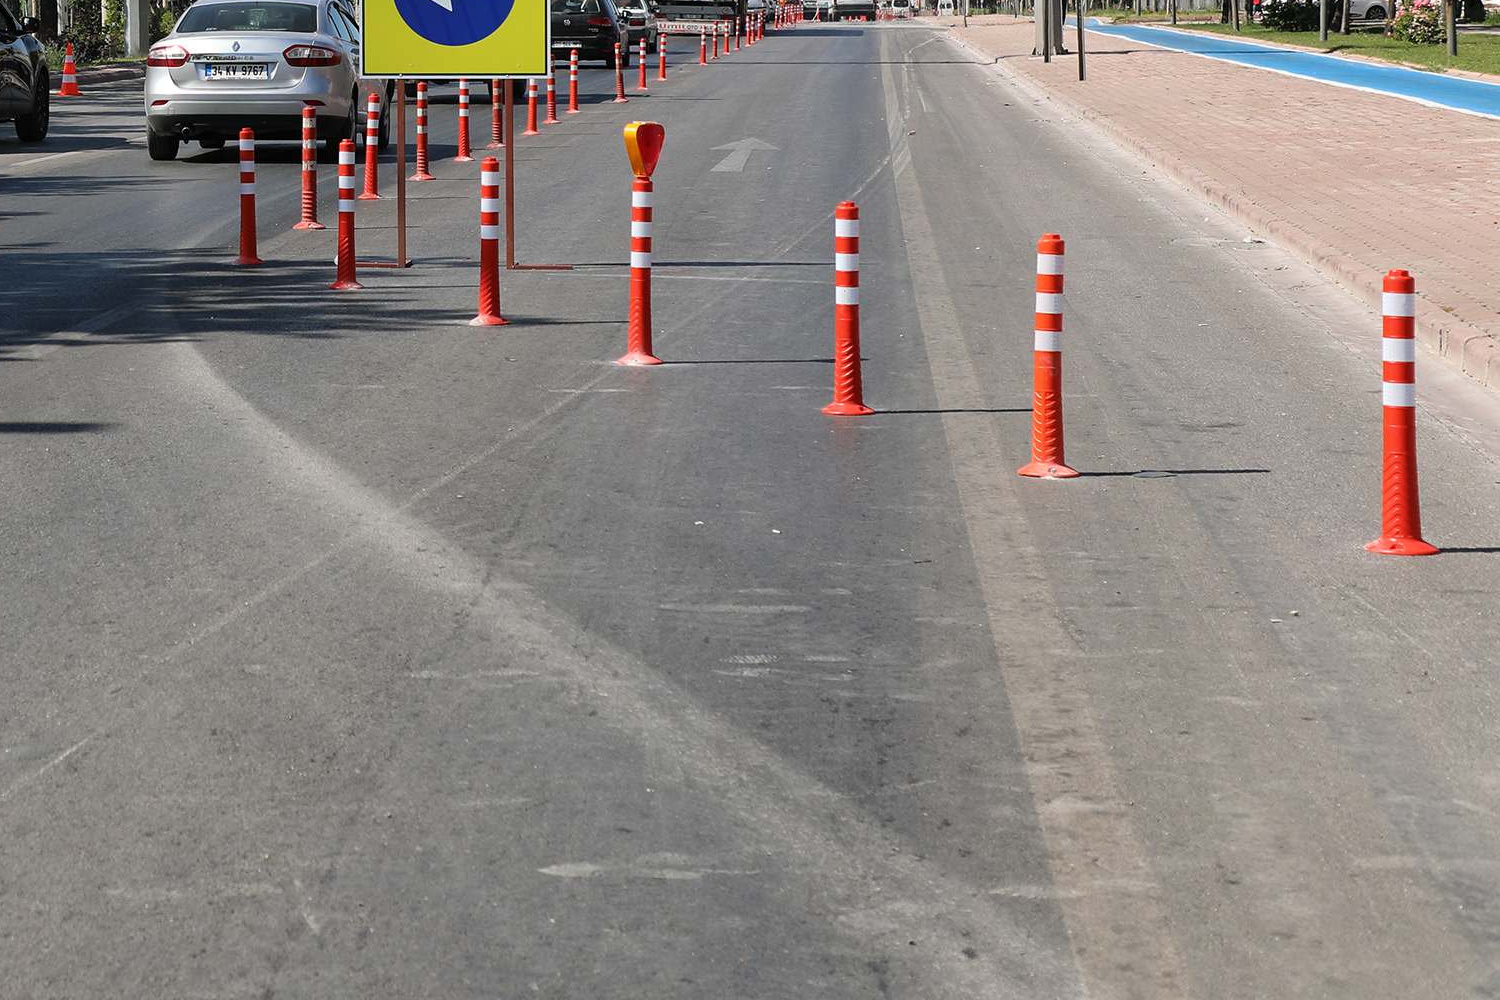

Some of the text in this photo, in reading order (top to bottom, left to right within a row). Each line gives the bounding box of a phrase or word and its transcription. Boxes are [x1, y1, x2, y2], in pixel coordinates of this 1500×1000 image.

[212, 66, 264, 76] 34 KV 9767
